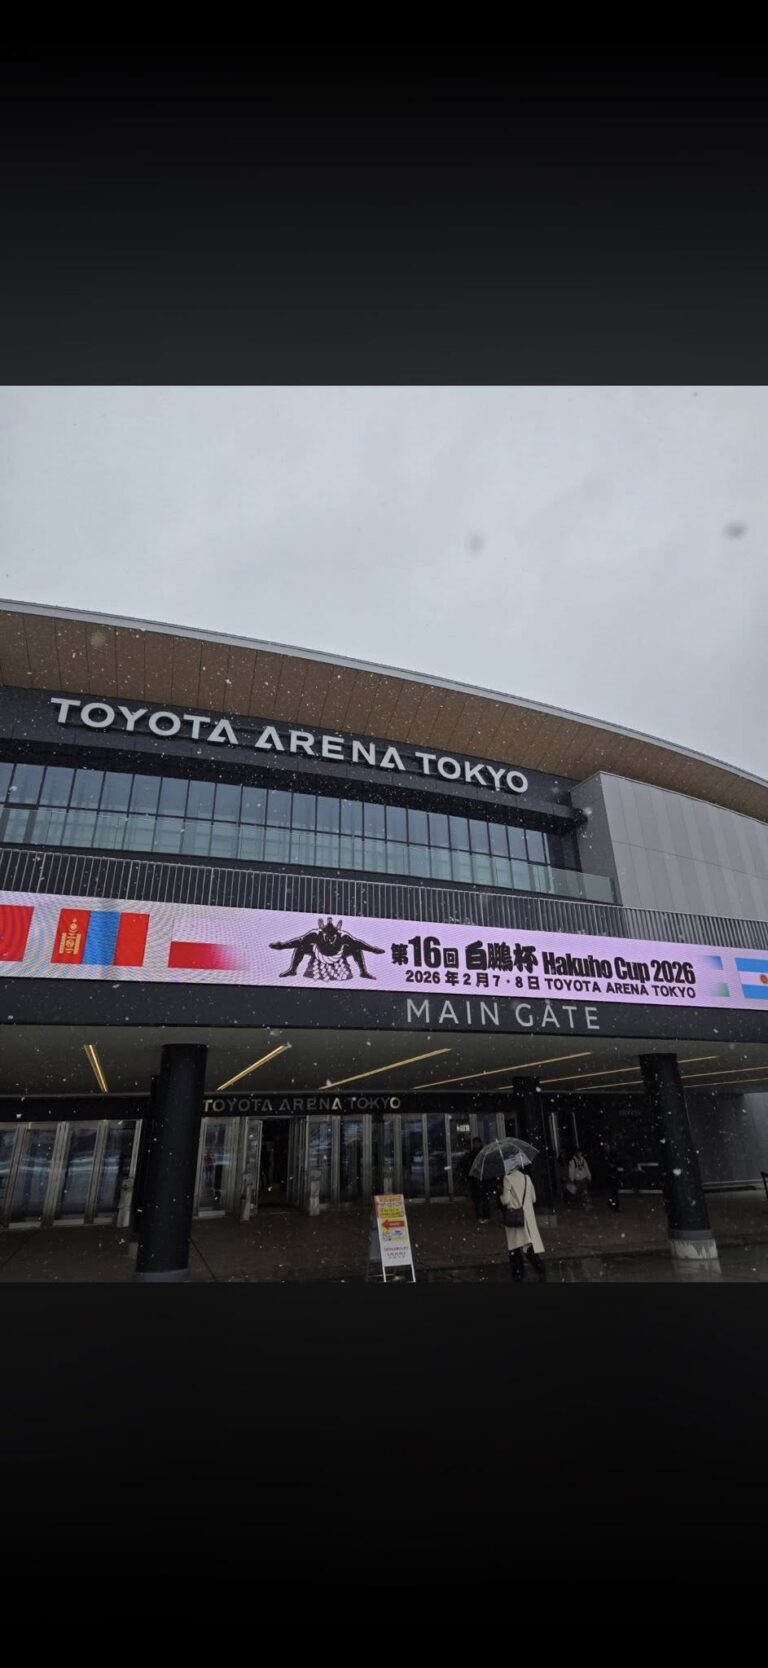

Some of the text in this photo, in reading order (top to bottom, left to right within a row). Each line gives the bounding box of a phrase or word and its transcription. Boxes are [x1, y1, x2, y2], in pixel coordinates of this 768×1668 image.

[50, 697, 529, 793] TOYOTA ARENA TOKYO
[391, 936, 697, 984] 第16回 白鵬杯 Hakuho Cup 2026
[545, 978, 601, 993] TOYOTA
[606, 982, 649, 996] ARENA
[652, 985, 696, 999] TOKYO
[406, 998, 600, 1029] MAIN GATE
[204, 1097, 401, 1112] TOYOTA ARENA TOKYO
